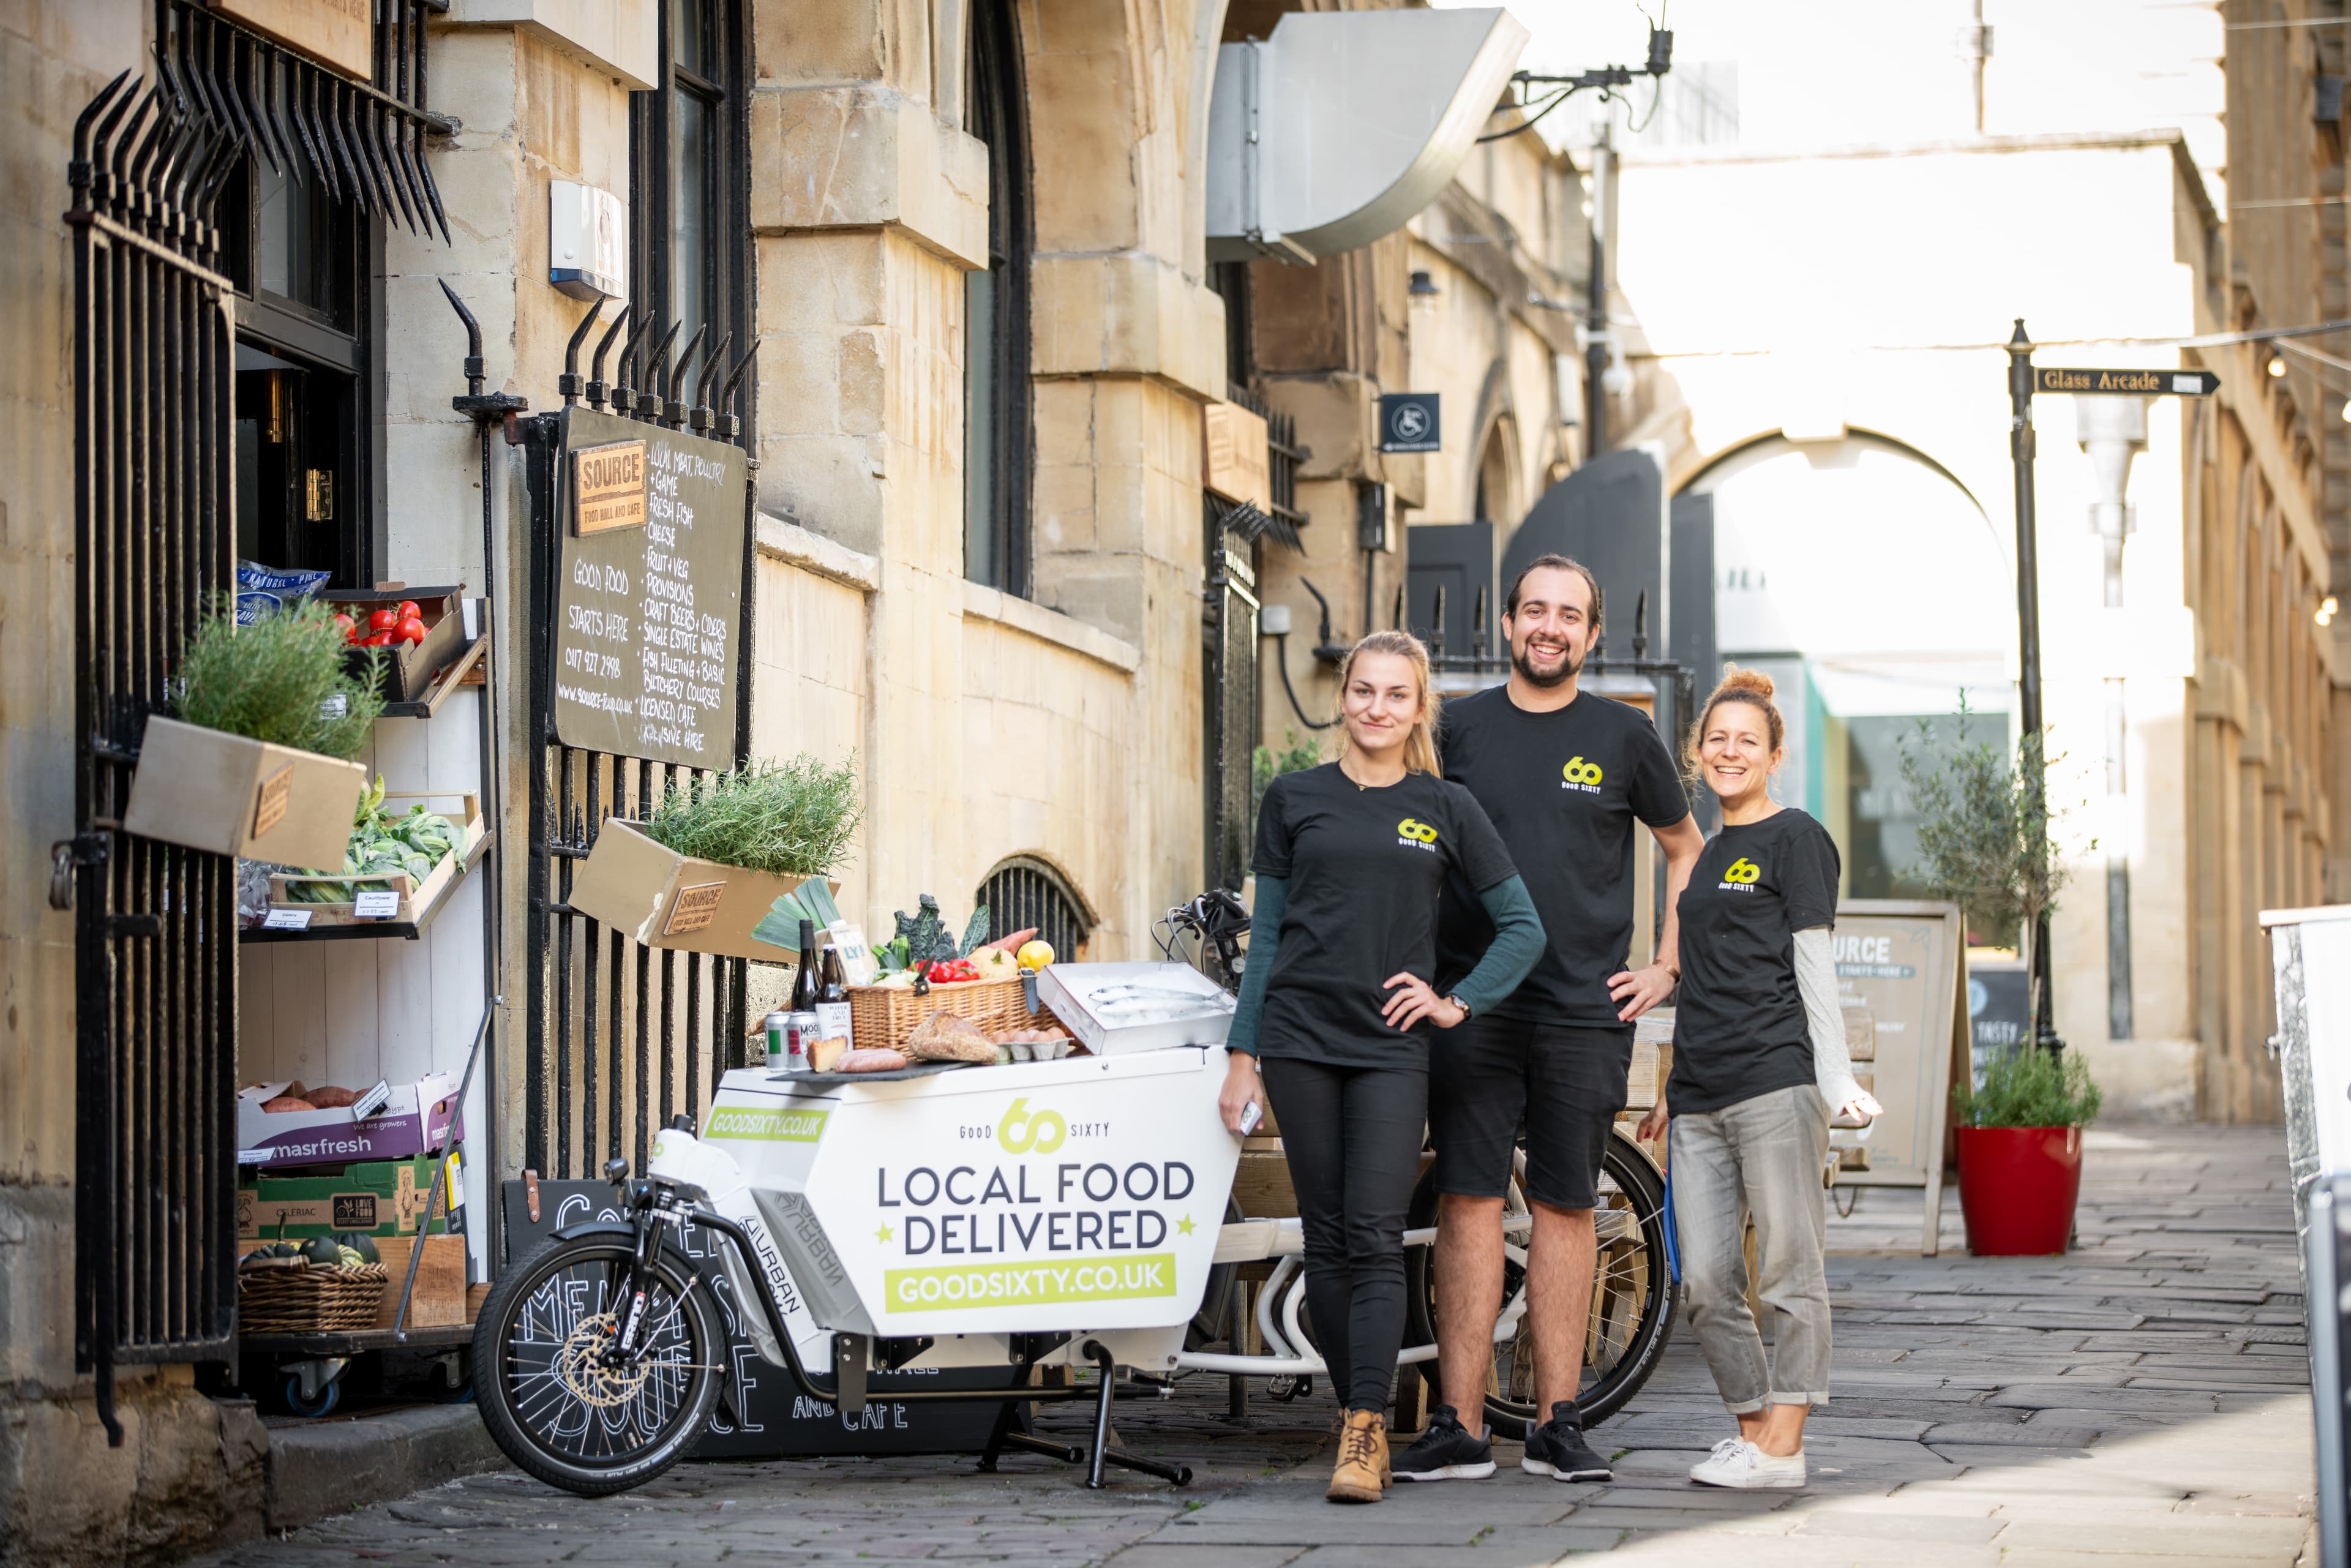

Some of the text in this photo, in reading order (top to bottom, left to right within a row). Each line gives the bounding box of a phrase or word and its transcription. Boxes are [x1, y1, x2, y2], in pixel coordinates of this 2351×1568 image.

[2044, 370, 2161, 391] Glass Arcade
[583, 454, 640, 490] SOURCE
[651, 442, 671, 472] LOCAL
[695, 456, 726, 486] POULTRY
[656, 470, 678, 496] GAME
[585, 503, 640, 523] FOOD HALL AND CAFE
[650, 492, 694, 529] FRESH FISH
[648, 522, 675, 546] CHEESE
[575, 558, 628, 595] GOOD FOOD
[647, 546, 668, 572] FRUIT
[673, 557, 689, 580] VEG
[249, 573, 286, 588] NATURAL
[647, 572, 694, 606] PROVISIONS
[569, 605, 629, 643] STARTS HERE
[645, 598, 669, 621] CRAFT
[670, 604, 695, 631] BEERS
[702, 613, 727, 641] CIDERS
[643, 621, 724, 662] SINGLE ESTATE WINES
[566, 647, 582, 672] 0117
[585, 651, 598, 676] 927
[643, 647, 658, 672] FISH
[661, 652, 695, 680] FILLETING
[702, 661, 725, 685] BASIC
[644, 669, 720, 710] BUTCHERY COURSES
[640, 696, 696, 729] LICENSED CAFE
[684, 729, 704, 752] HIRE
[1581, 784, 1601, 794] SIXTY
[1419, 841, 1436, 852] SIXTY
[681, 889, 721, 909] SOURCE
[1733, 882, 1754, 893] SIXTY
[1831, 936, 1891, 963] URCE
[800, 1024, 819, 1037] MOO
[1976, 1021, 2018, 1044] TASTY
[386, 1105, 405, 1114] gypt
[380, 1120, 407, 1130] growers
[713, 1113, 822, 1136] GOODSIXTY.CO.UK
[1071, 1122, 1109, 1137] SIXTY
[274, 1136, 372, 1158] masrfresh
[879, 1161, 1194, 1207] LOCAL FOOD
[356, 1199, 372, 1208] LOVE
[905, 1210, 1168, 1255] DELIVERED
[756, 1233, 800, 1313] URBAN
[898, 1262, 1164, 1304] GOODSIXTY.CO.UK
[621, 1294, 645, 1350] GRIND
